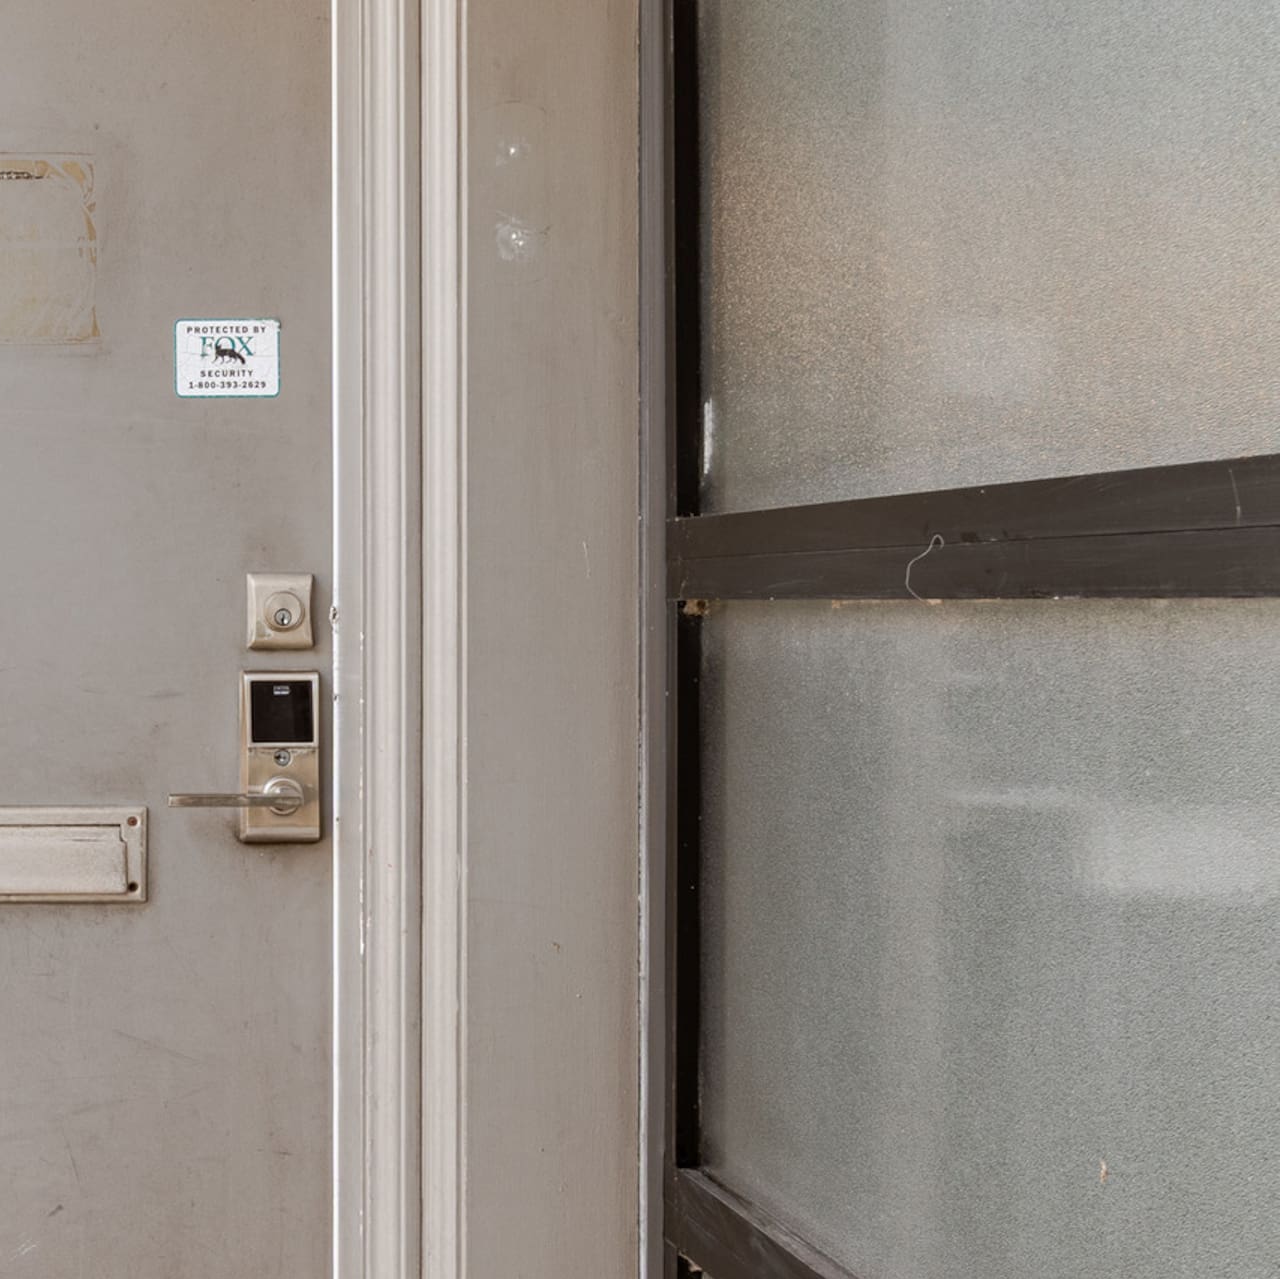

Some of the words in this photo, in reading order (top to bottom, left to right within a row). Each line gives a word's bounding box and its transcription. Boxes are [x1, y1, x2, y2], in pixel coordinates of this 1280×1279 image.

[186, 326, 249, 334] PROTECTED
[253, 326, 267, 334] BY
[199, 336, 255, 357] FOX
[200, 369, 254, 378] SECURITY
